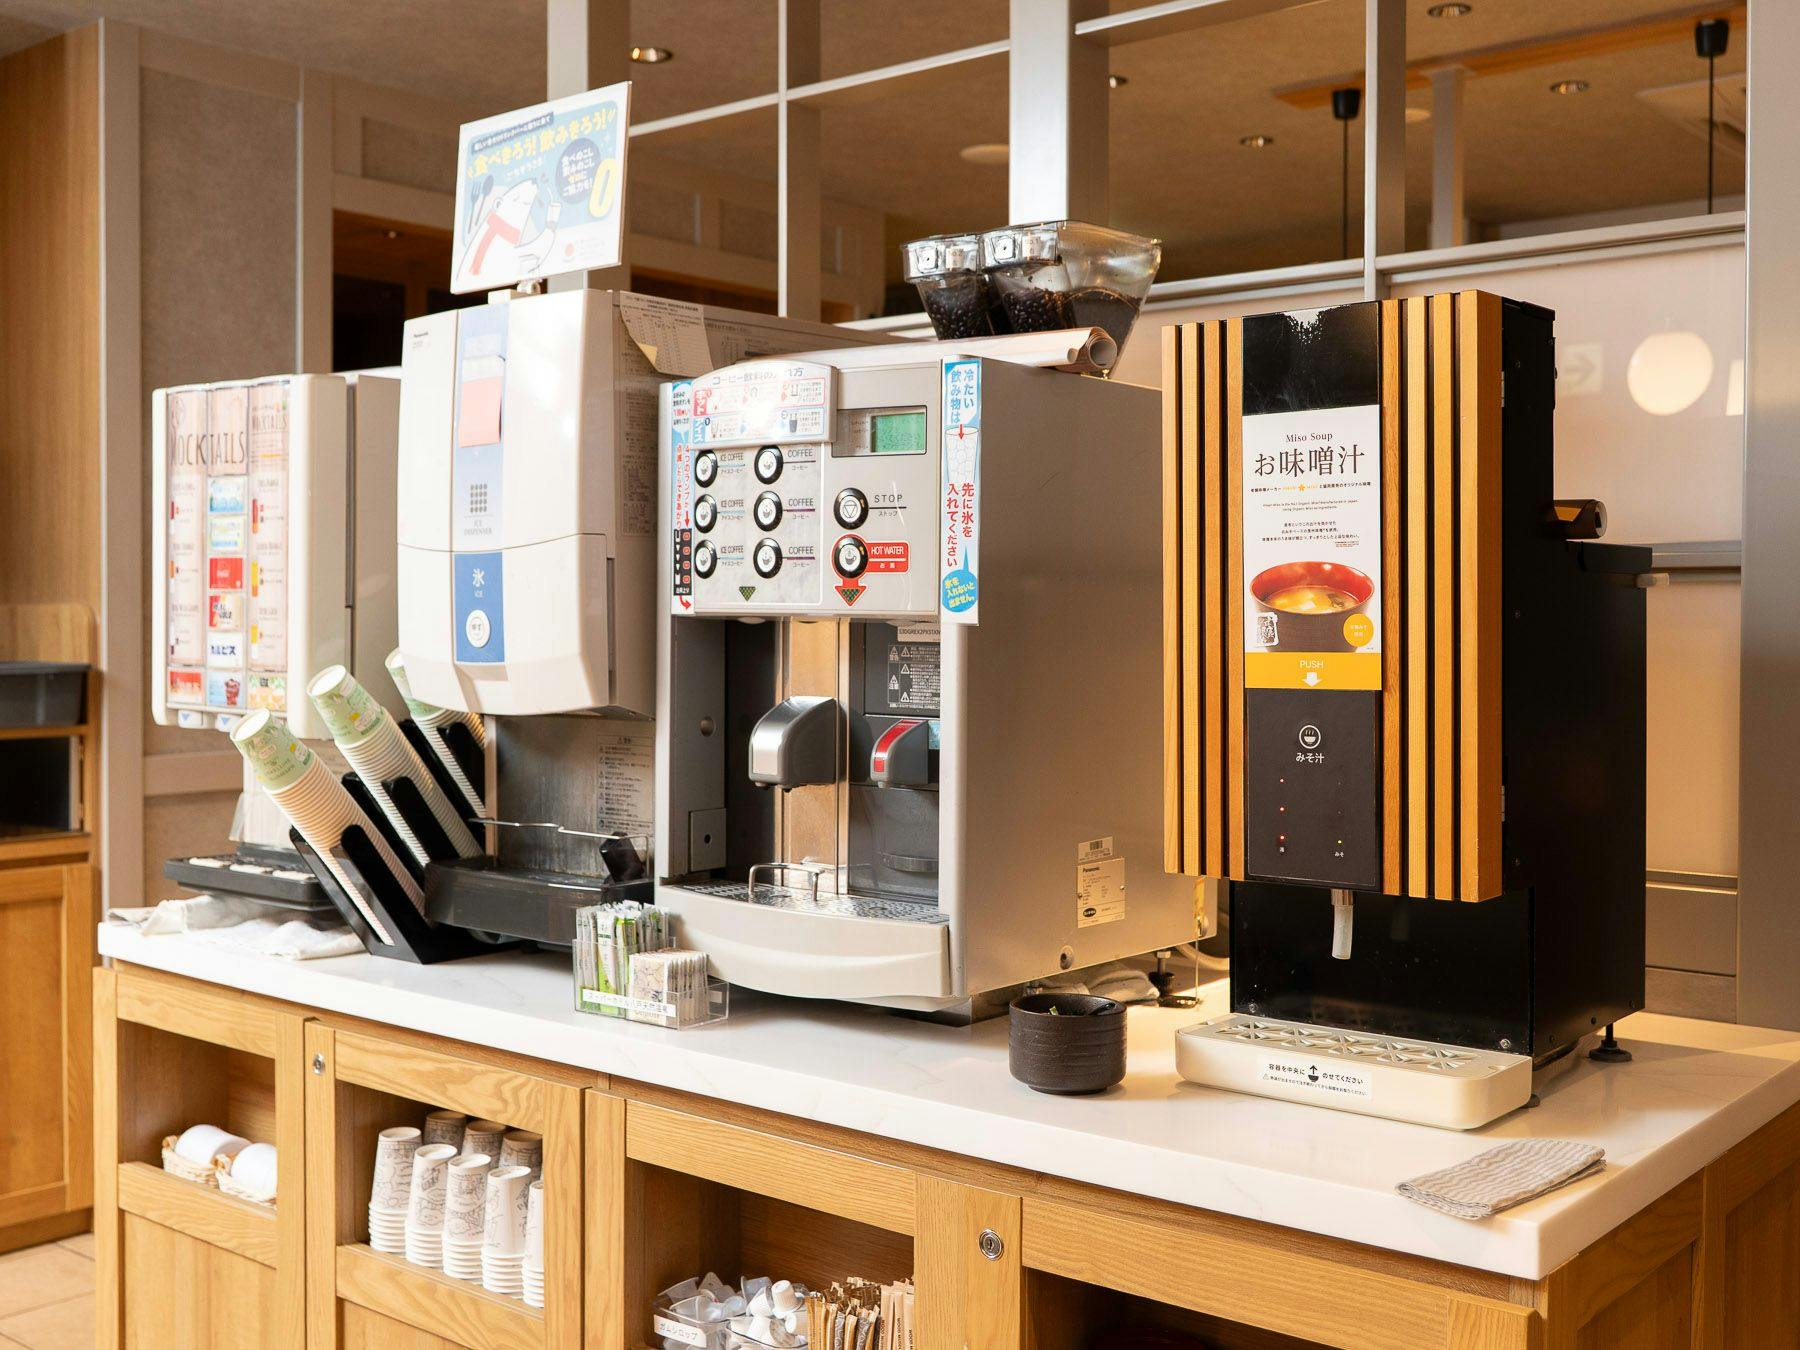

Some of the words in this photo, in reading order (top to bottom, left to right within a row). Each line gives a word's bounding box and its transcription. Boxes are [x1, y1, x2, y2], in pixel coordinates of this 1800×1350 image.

[963, 368, 974, 409] 冷たい
[950, 369, 961, 424] 飲み物は
[1286, 434, 1307, 443] Miso
[1310, 432, 1333, 442] Soup
[727, 453, 744, 461] COFFEE
[787, 449, 813, 458] COFFEE
[1254, 444, 1365, 478] お味噌汁
[727, 499, 744, 507] COFFEE
[788, 498, 813, 506] COFFEE
[874, 494, 903, 503] STOP
[961, 482, 974, 538] 先に氷を
[946, 483, 959, 568] 入れてください
[727, 545, 744, 553] COFFEE
[788, 546, 814, 555] COFFEE
[871, 546, 883, 556] HOT
[884, 546, 904, 555] WATER
[473, 568, 485, 587] 氷
[1299, 660, 1324, 669] PUSH
[1295, 753, 1325, 764] みそ汁
[1268, 1063, 1305, 1076] 容器を中央に
[1322, 1072, 1364, 1085] のせてください
